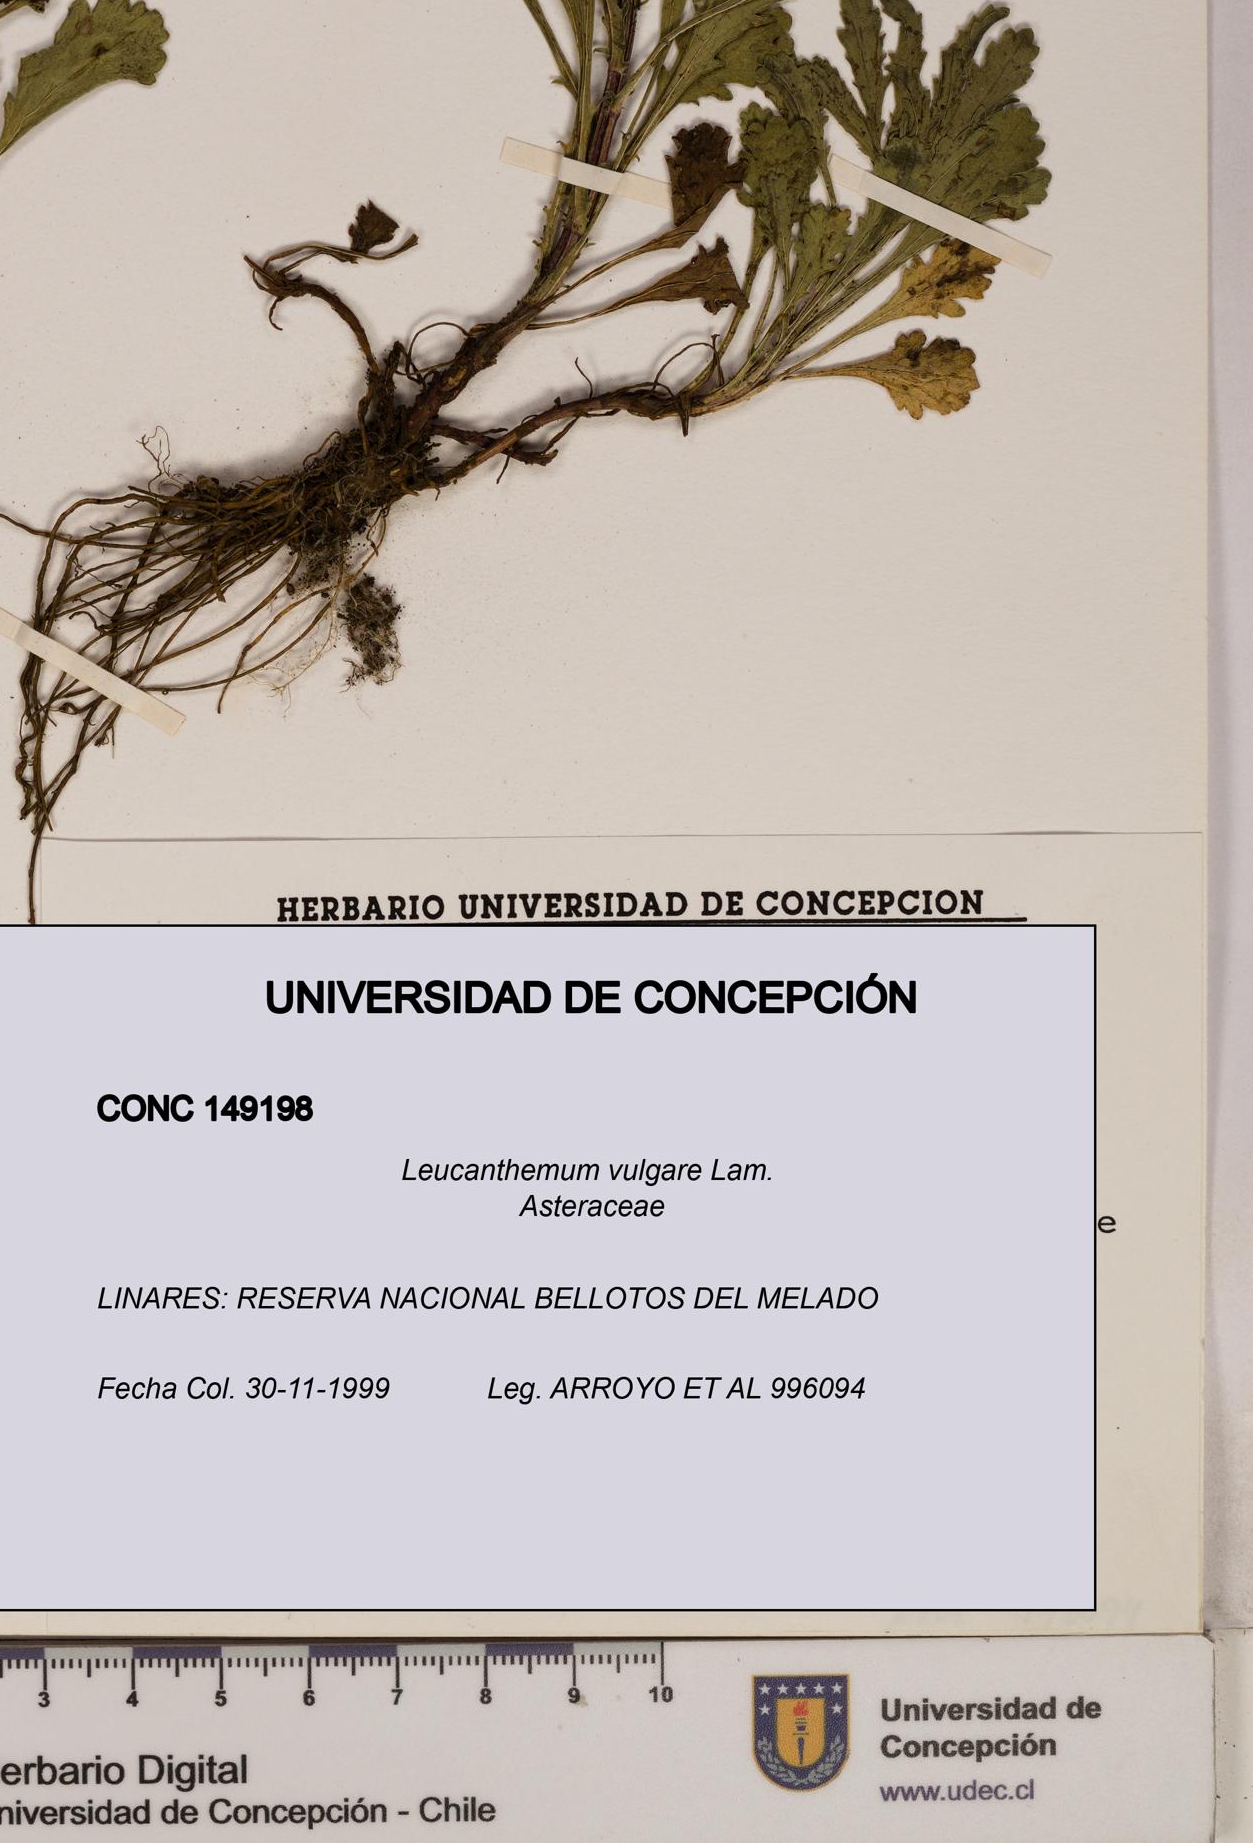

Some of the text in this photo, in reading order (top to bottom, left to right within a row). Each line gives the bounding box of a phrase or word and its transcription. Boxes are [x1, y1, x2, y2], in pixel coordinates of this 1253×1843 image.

[277, 889, 984, 922] HERBARIO UNIVERSIDAD DE CONCEPCION
[38, 1691, 51, 1708] 3
[125, 1691, 140, 1707] 4
[214, 1690, 228, 1707] 5
[302, 1690, 316, 1707] 6
[391, 1689, 404, 1706] 7
[479, 1689, 493, 1705] 8
[567, 1688, 581, 1704] 9
[648, 1687, 674, 1703] 10
[881, 1695, 1102, 1722] Universidad de
[880, 1732, 1057, 1763] Concepción
[138, 1753, 248, 1792] Digital
[879, 1778, 1035, 1802] www.udec.cl
[160, 1798, 199, 1825] de
[208, 1797, 388, 1830] Concepción
[419, 1796, 497, 1823] Chile
